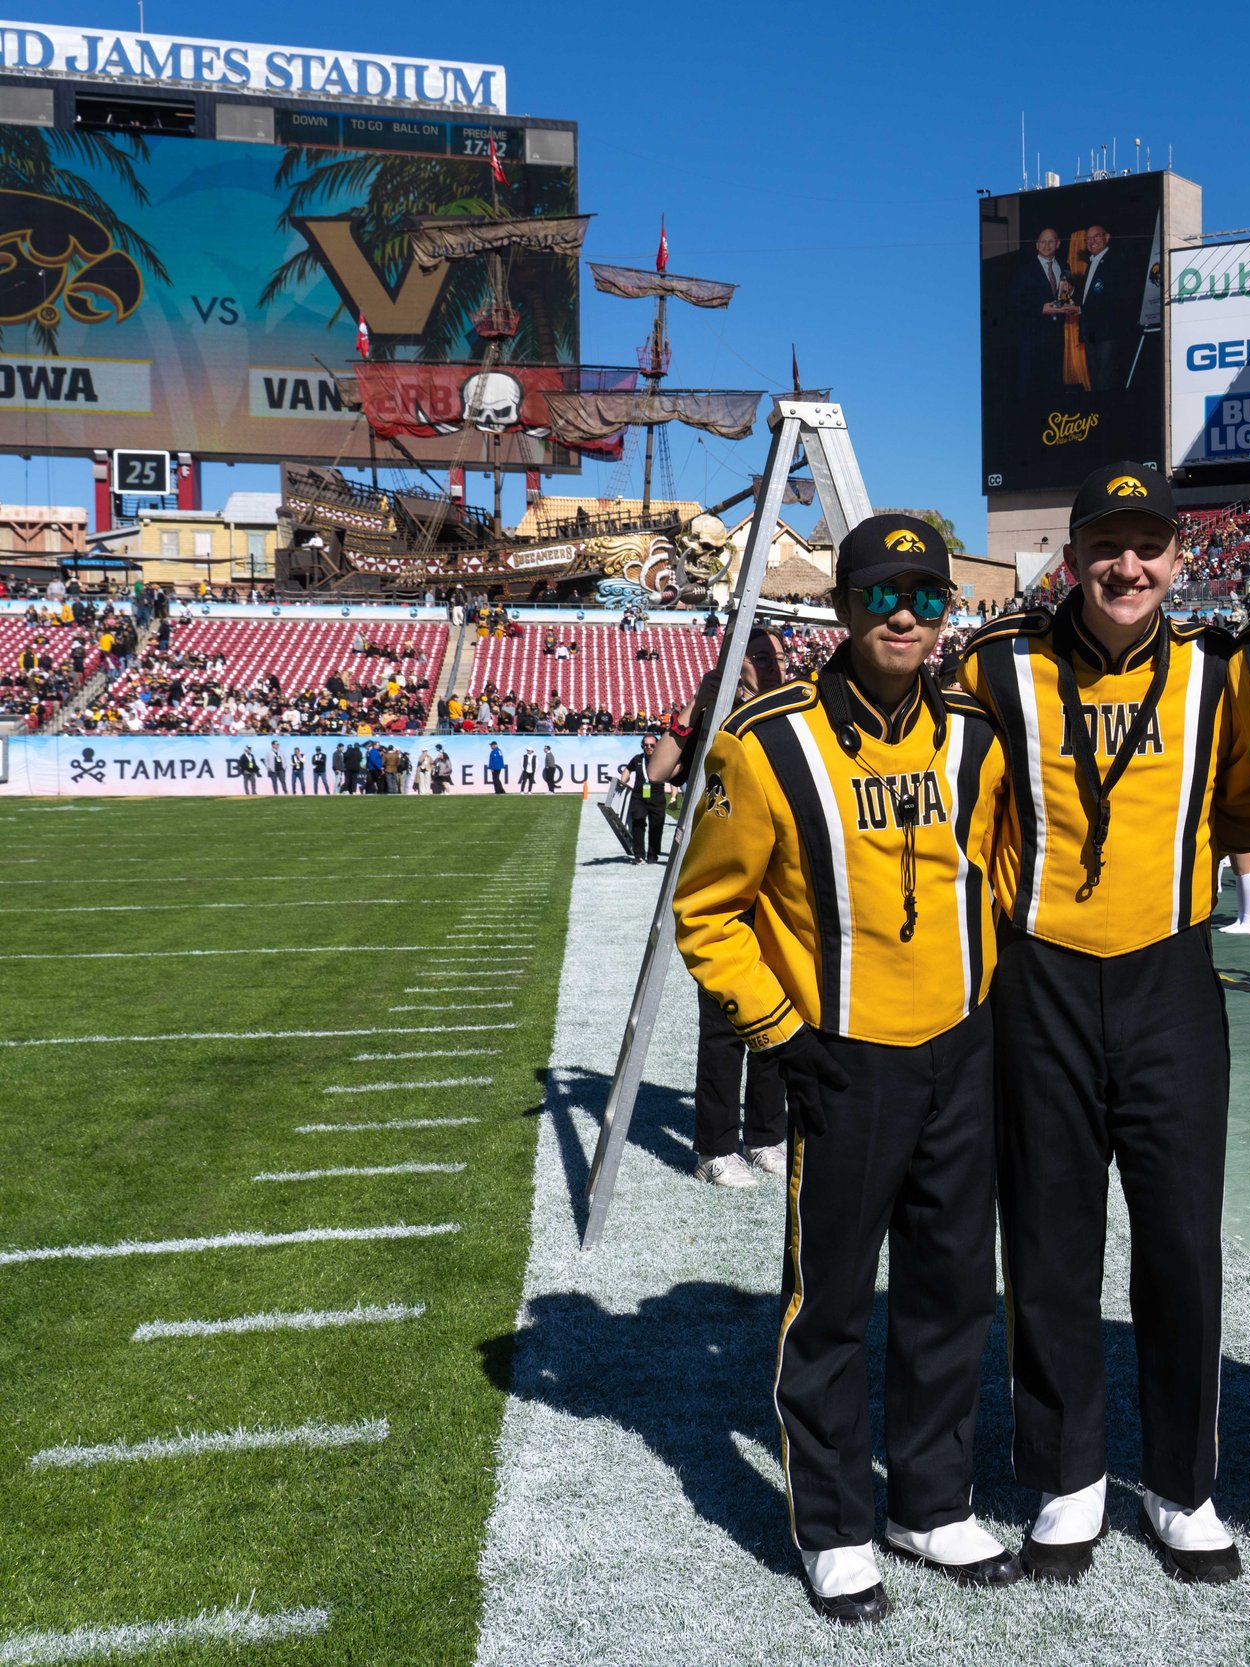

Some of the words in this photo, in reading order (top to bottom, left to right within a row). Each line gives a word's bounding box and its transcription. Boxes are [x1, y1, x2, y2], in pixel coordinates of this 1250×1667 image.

[0, 27, 55, 69] D
[65, 34, 251, 86] JAMES
[264, 51, 497, 107] STADIUM
[292, 114, 328, 127] DOWN
[352, 119, 366, 131] TO
[367, 120, 383, 132] GO
[392, 122, 420, 134] BALL
[422, 124, 439, 136] ON
[462, 127, 508, 141] PREGAME
[191, 295, 239, 326] VS
[1042, 411, 1100, 445] Stacy's
[125, 460, 158, 484] 25
[989, 475, 1001, 485] CC
[114, 759, 215, 780] TAMPA
[850, 769, 947, 832] IOWA
